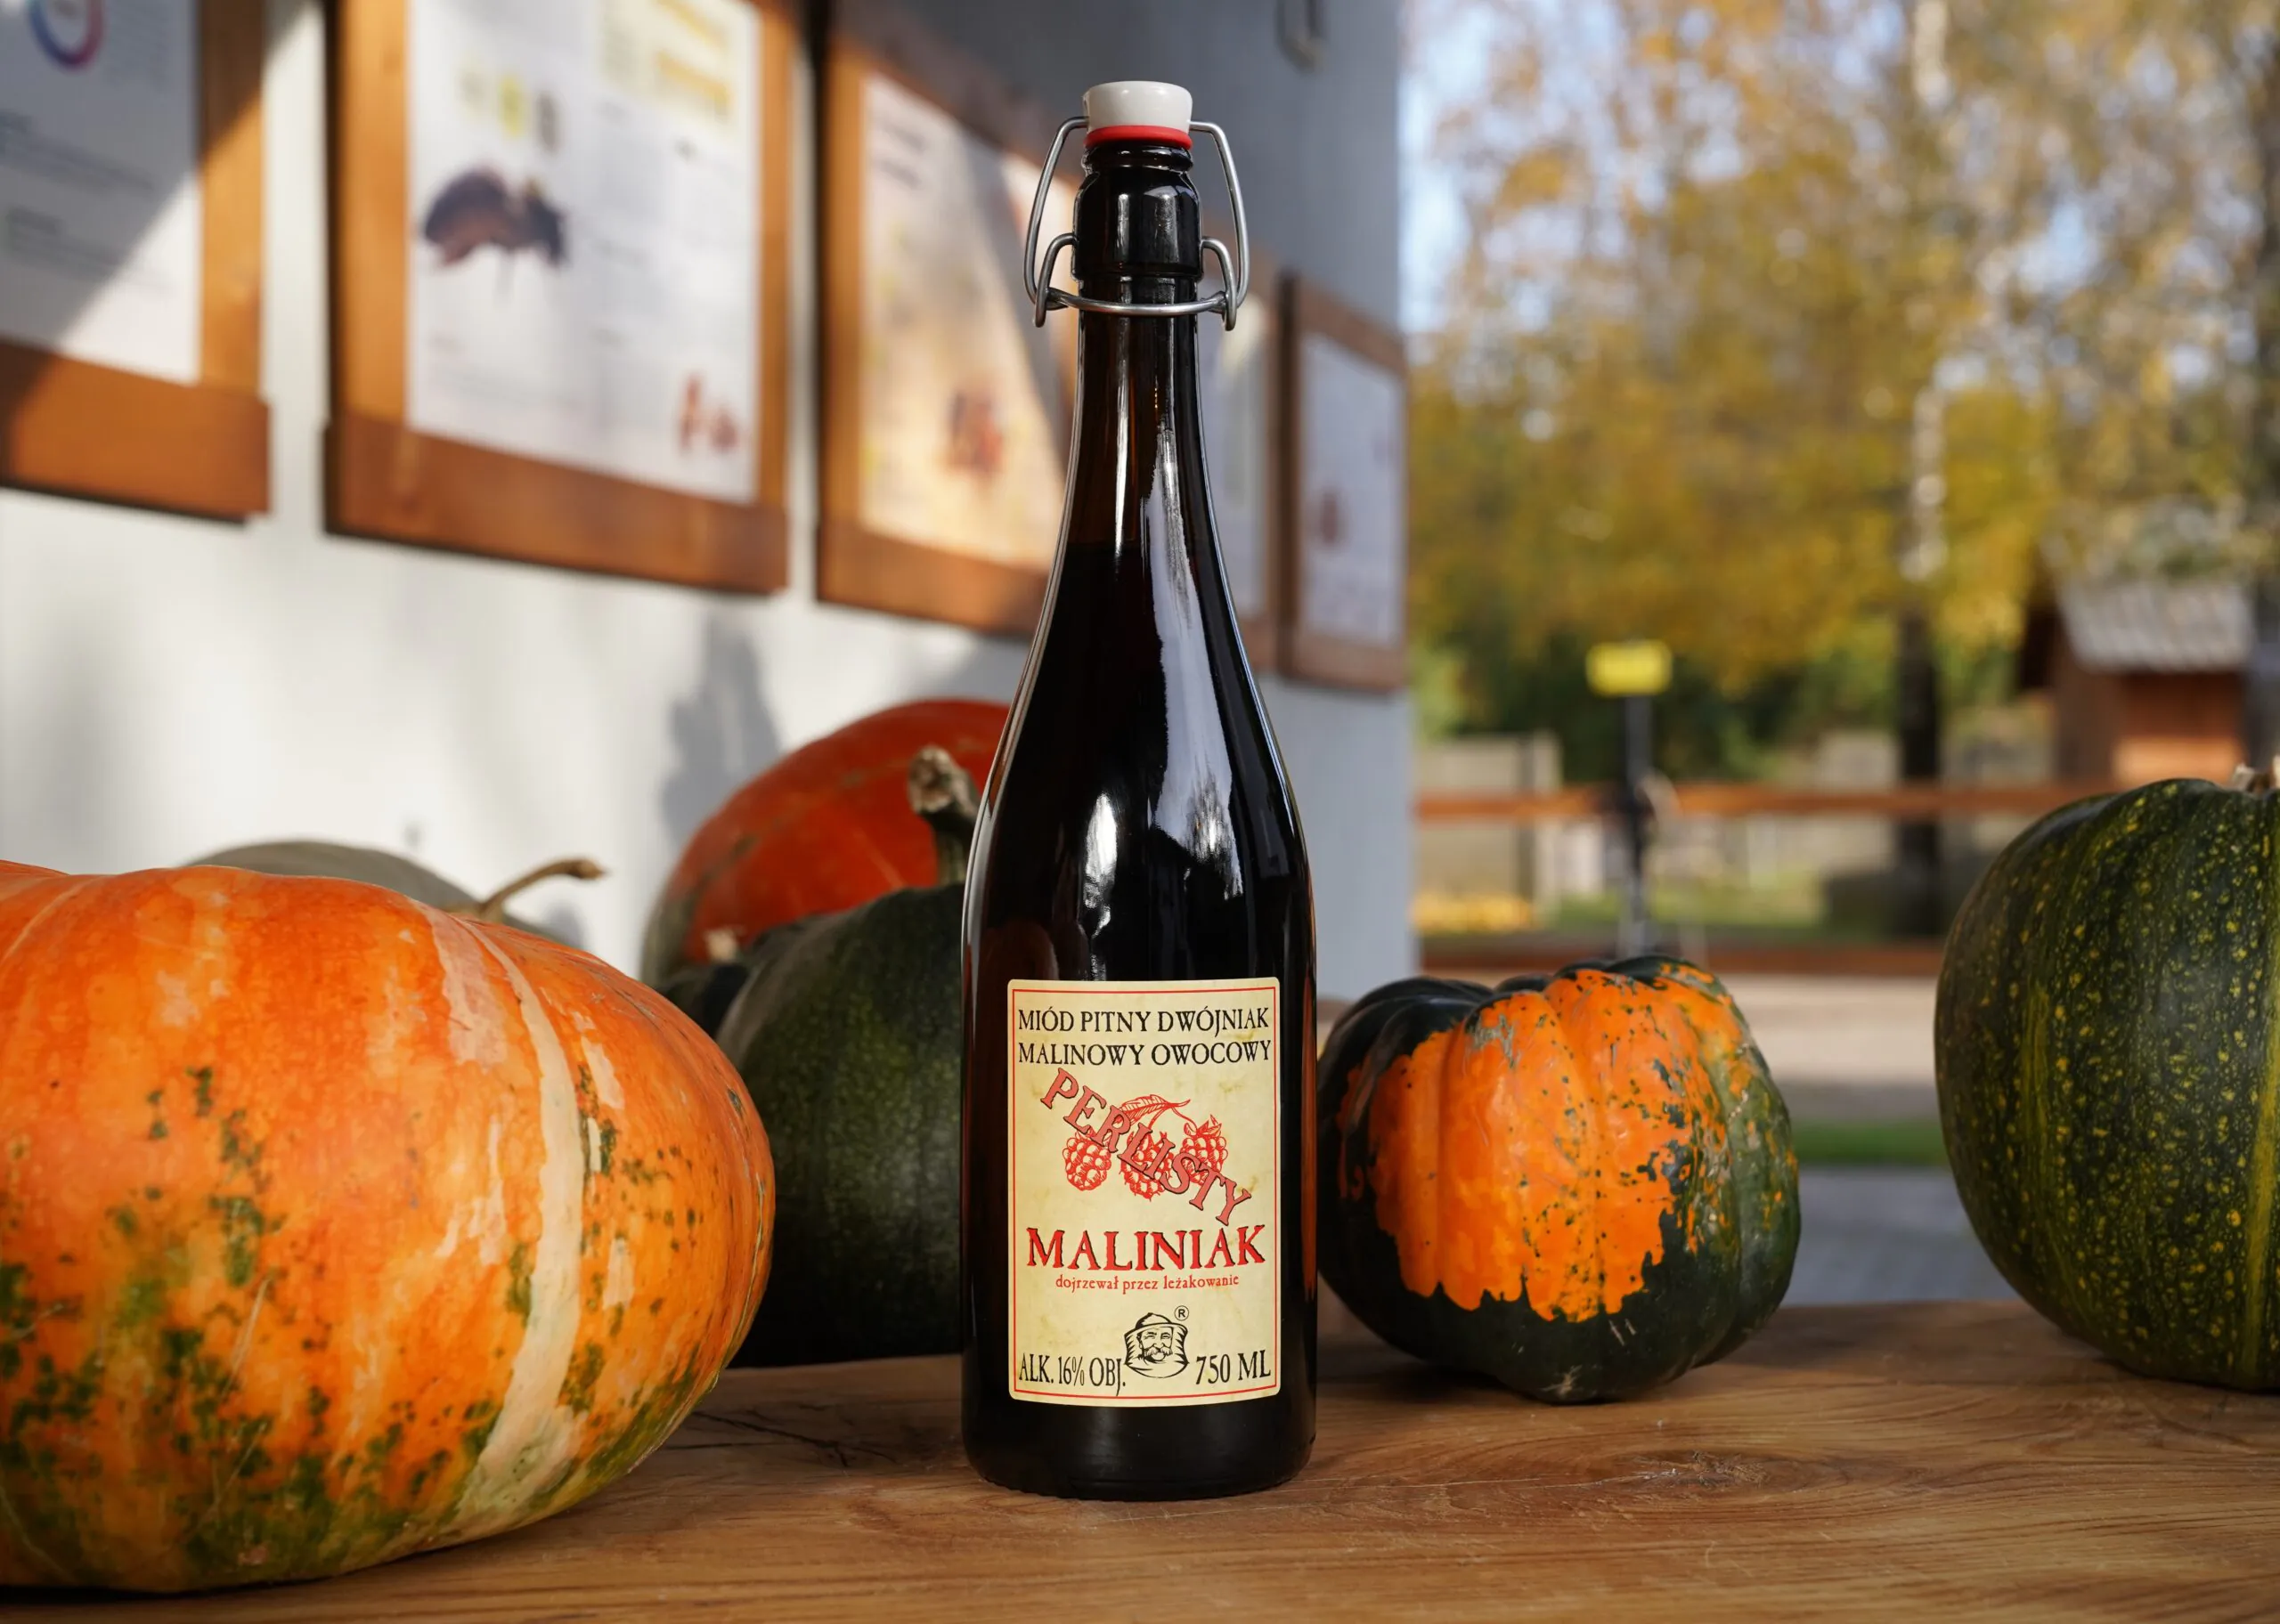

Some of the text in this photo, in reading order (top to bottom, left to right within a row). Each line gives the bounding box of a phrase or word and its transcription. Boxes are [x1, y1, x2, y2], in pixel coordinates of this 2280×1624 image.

[1018, 1005, 1269, 1038] MIÓD PITNY DWÓJNIAK
[1018, 1040, 1272, 1066] MALINOWY OWOCOWY
[1040, 1068, 1252, 1226] PERLISTY
[1026, 1224, 1266, 1271] MALINIAK
[1055, 1274, 1239, 1295] dojrzewał przez leżakowanie
[1018, 1352, 1126, 1397] ALK. 16% OBJ.
[1195, 1350, 1271, 1384] 750 ML
